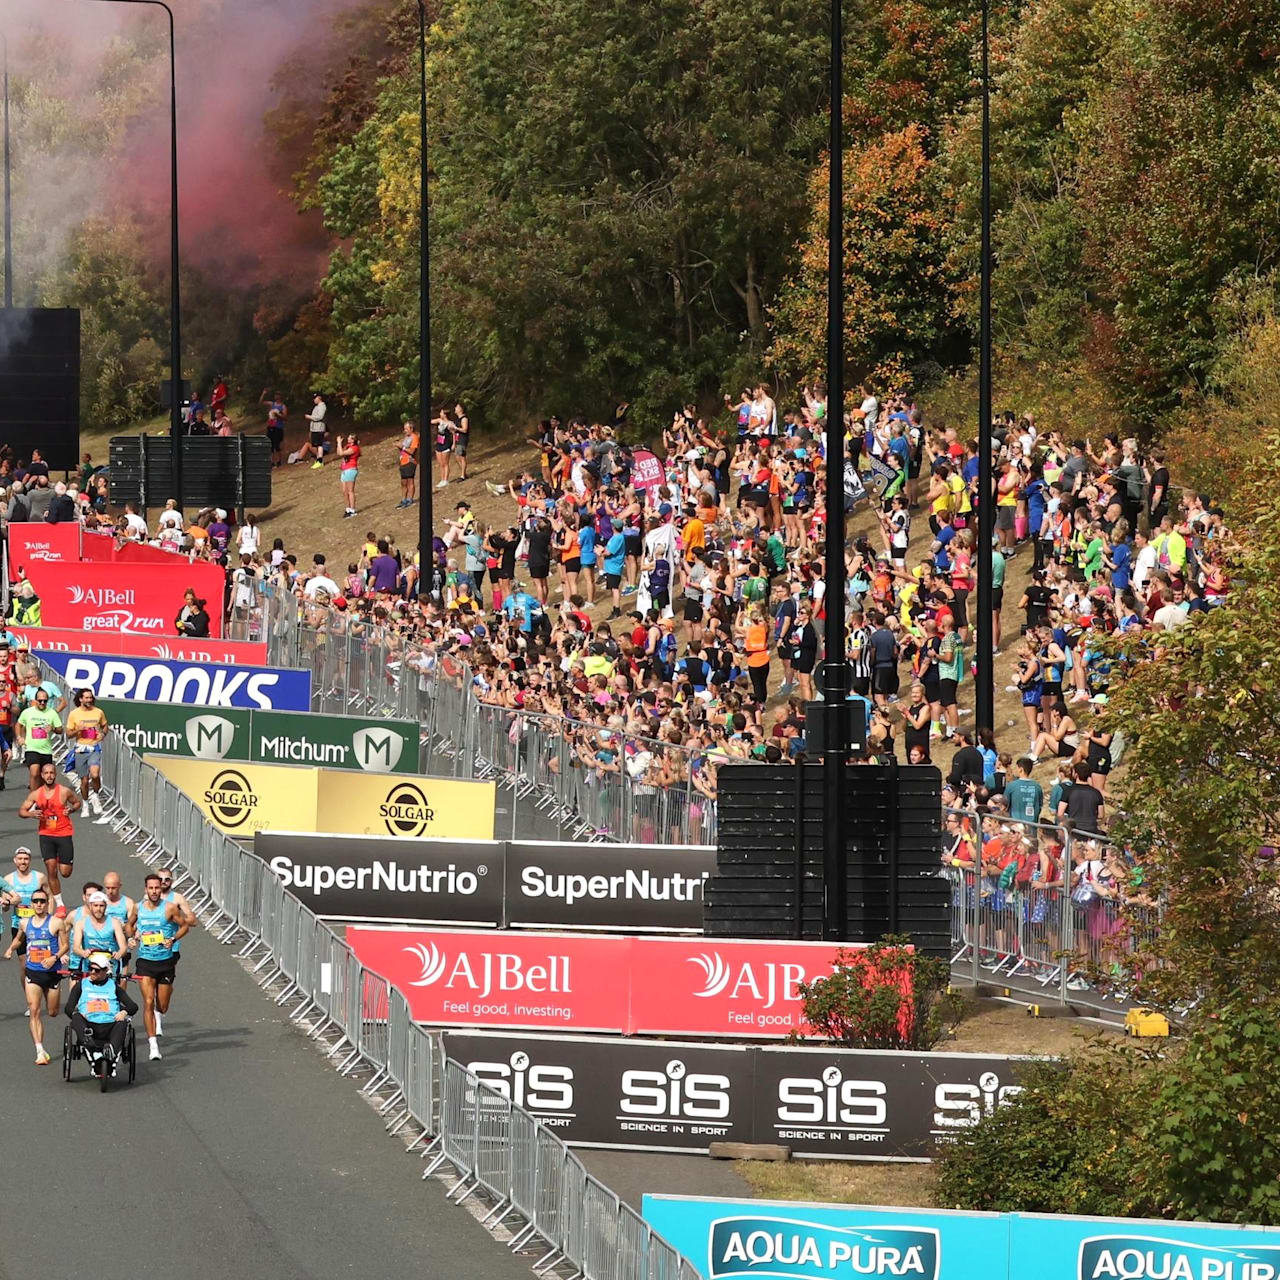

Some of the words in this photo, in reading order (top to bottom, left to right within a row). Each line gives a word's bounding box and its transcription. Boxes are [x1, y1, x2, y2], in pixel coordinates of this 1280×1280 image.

[83, 589, 135, 607] AJBell
[83, 614, 119, 631] great
[134, 618, 164, 628] run
[110, 723, 178, 750] itchum
[261, 736, 345, 763] Mitchum
[204, 790, 258, 807] SOLGAR
[380, 804, 434, 821] SOLGAR
[521, 867, 708, 904] SuperNutri
[446, 952, 572, 998] AJBell
[443, 1001, 470, 1014] Feel
[472, 1002, 511, 1018] good,
[514, 1003, 574, 1020] investing.
[728, 1011, 754, 1024] Feel
[757, 1012, 793, 1026] good,
[620, 1060, 730, 1118] SiS
[777, 1066, 887, 1124] SiS
[620, 1122, 668, 1133] SCIENCE
[672, 1125, 684, 1133] IN
[691, 1126, 728, 1135] SPORT
[778, 1130, 825, 1140] SCIENCE
[829, 1132, 842, 1140] IN
[848, 1133, 885, 1142] SPORT
[722, 1230, 823, 1268] AQUA
[828, 1240, 925, 1277] PURA
[1092, 1247, 1194, 1280] AQUA
